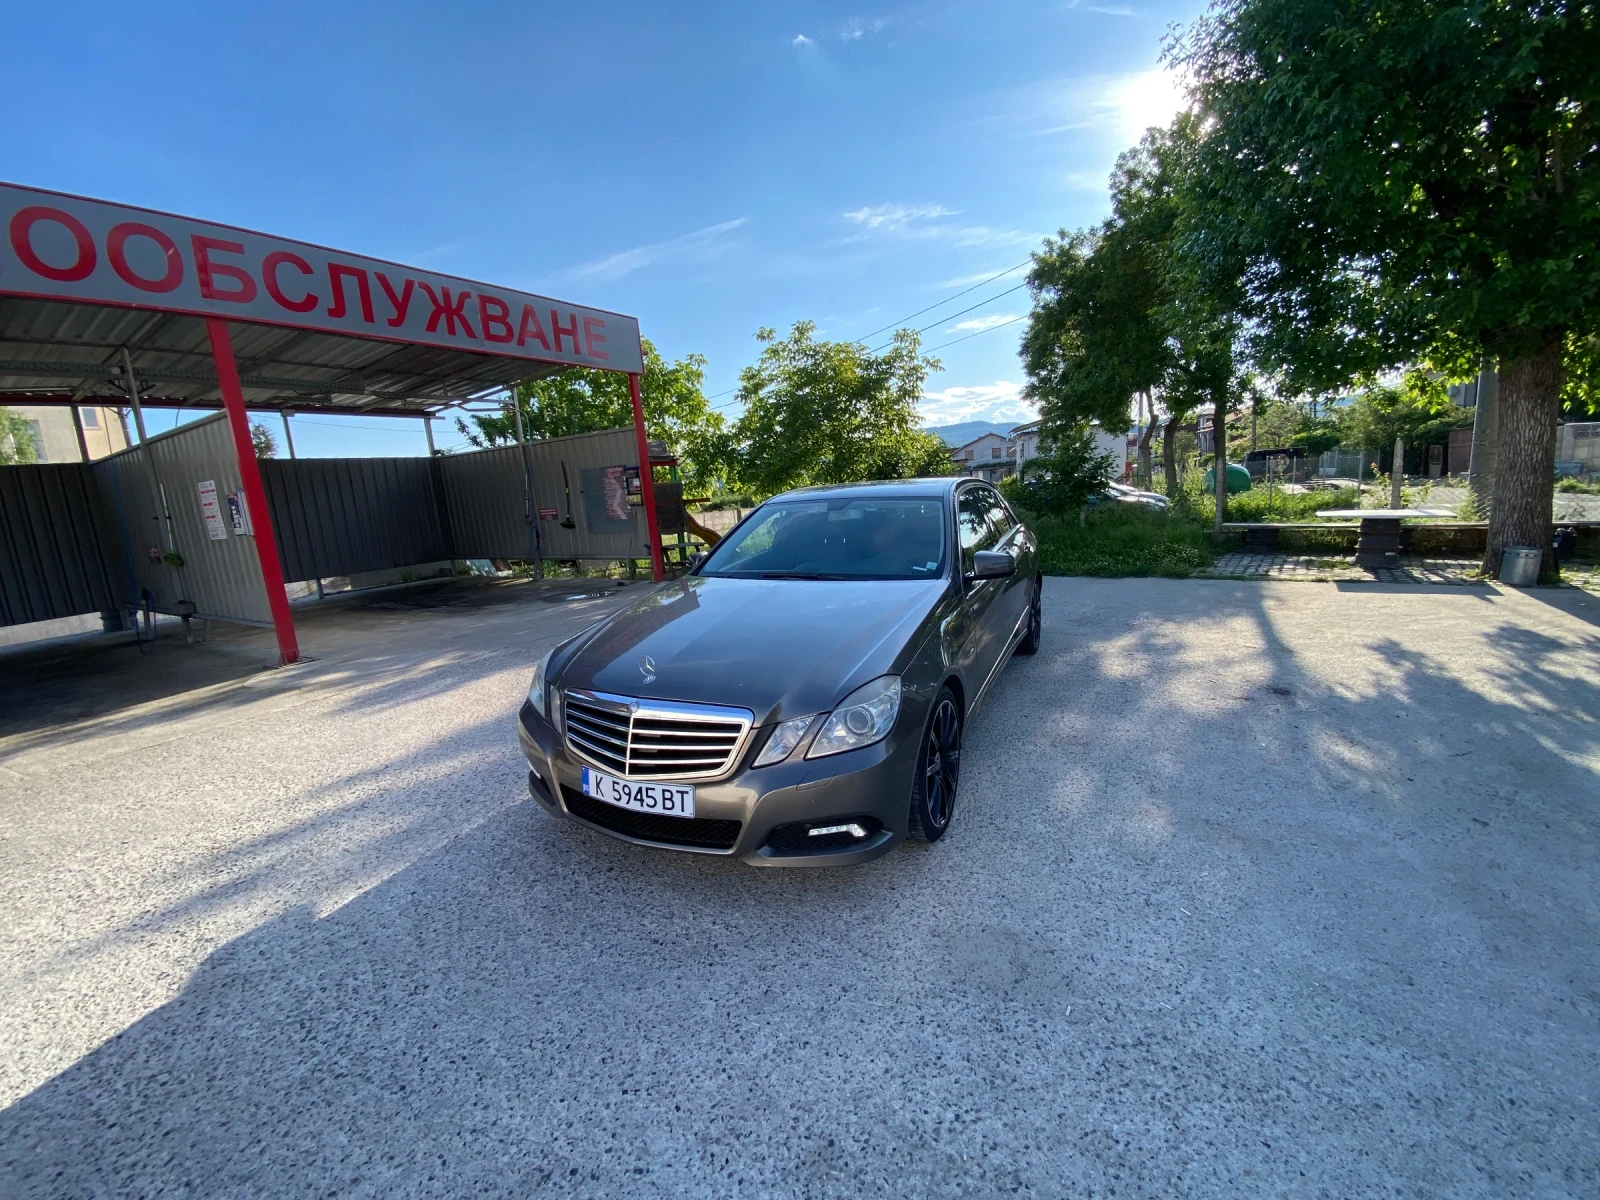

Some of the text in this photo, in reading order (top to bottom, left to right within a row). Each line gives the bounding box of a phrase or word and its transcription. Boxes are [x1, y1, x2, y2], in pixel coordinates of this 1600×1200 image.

[9, 206, 610, 360] ООБСЛУЖВАНЕ
[595, 775, 689, 812] K 5945 BT
